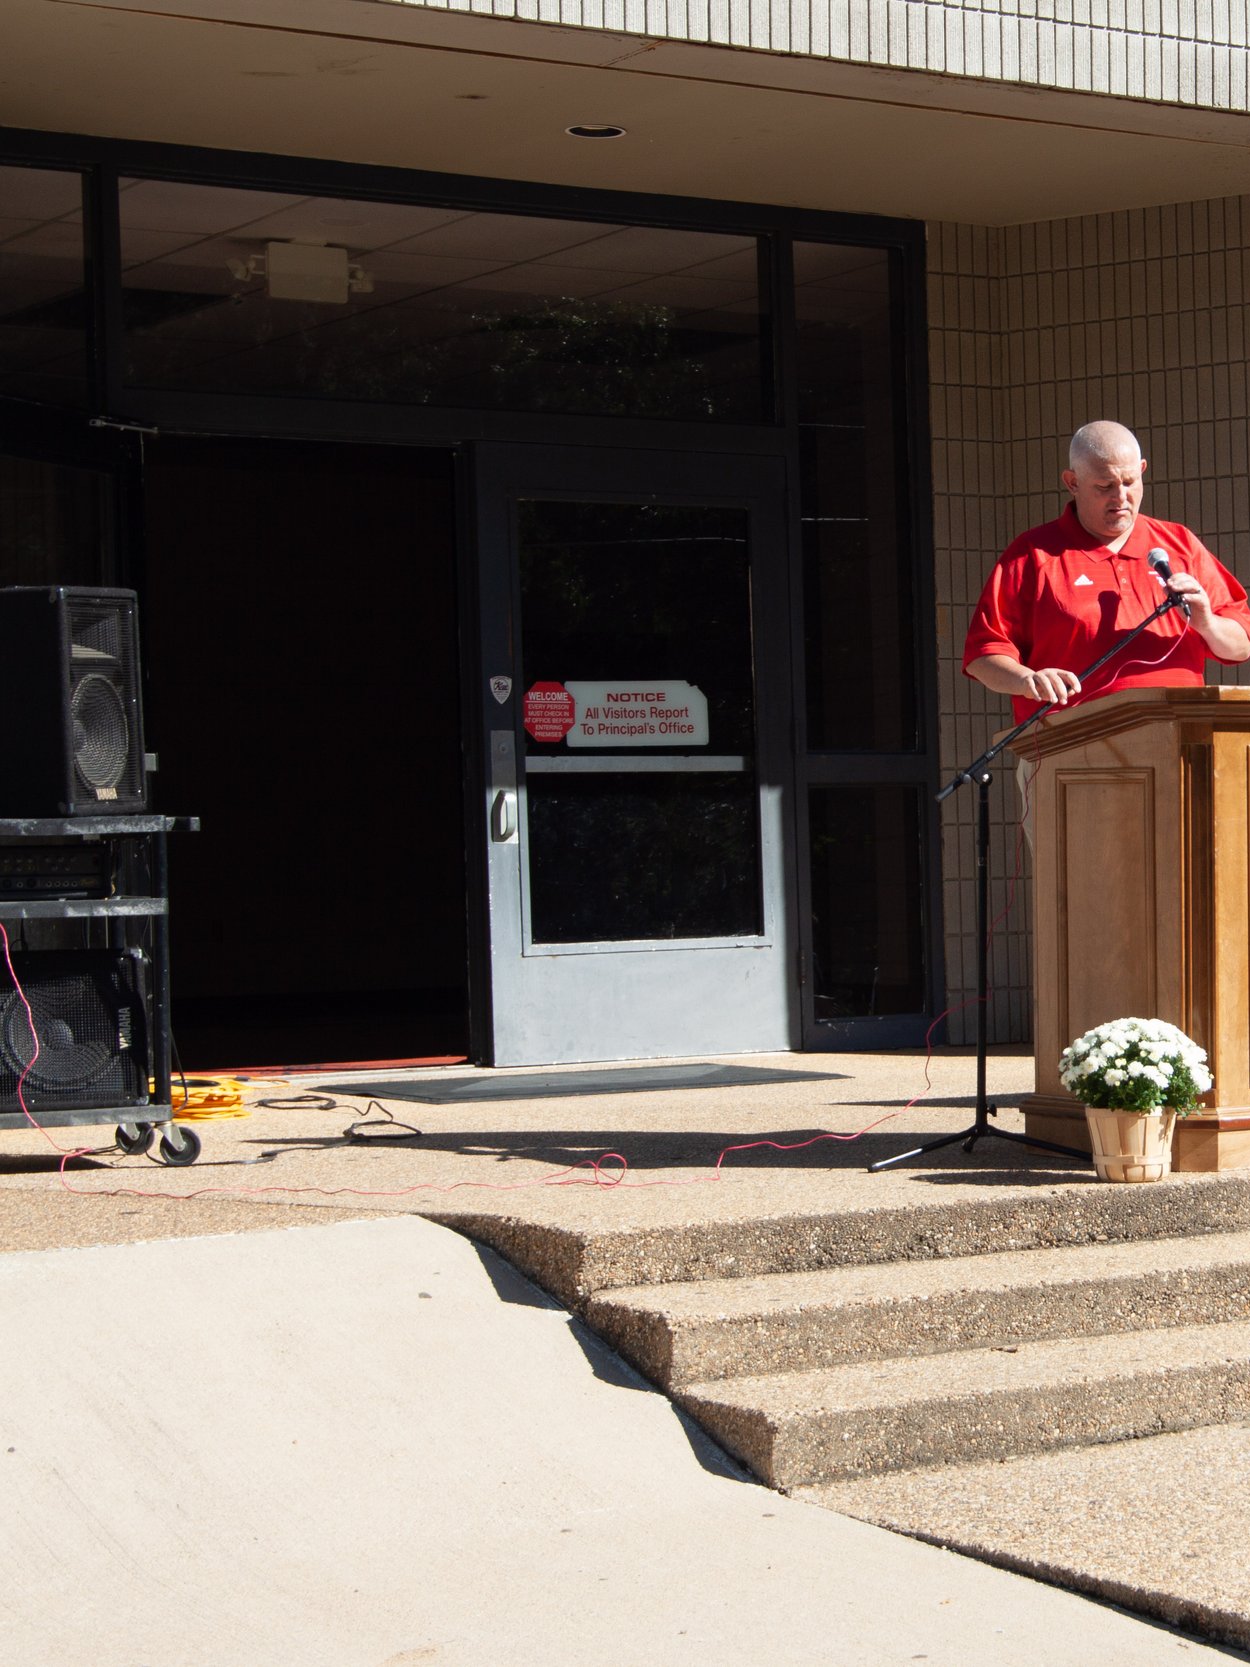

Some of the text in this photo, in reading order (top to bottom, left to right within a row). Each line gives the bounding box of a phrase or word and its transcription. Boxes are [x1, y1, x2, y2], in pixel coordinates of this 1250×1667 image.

[528, 692, 568, 700] WELCOME
[606, 692, 666, 702] NOTICE
[585, 706, 689, 720] All Visitors Report
[580, 722, 695, 736] To Principal's Office
[95, 787, 118, 801] YAMAHA
[118, 1006, 132, 1050] YAMAHA
